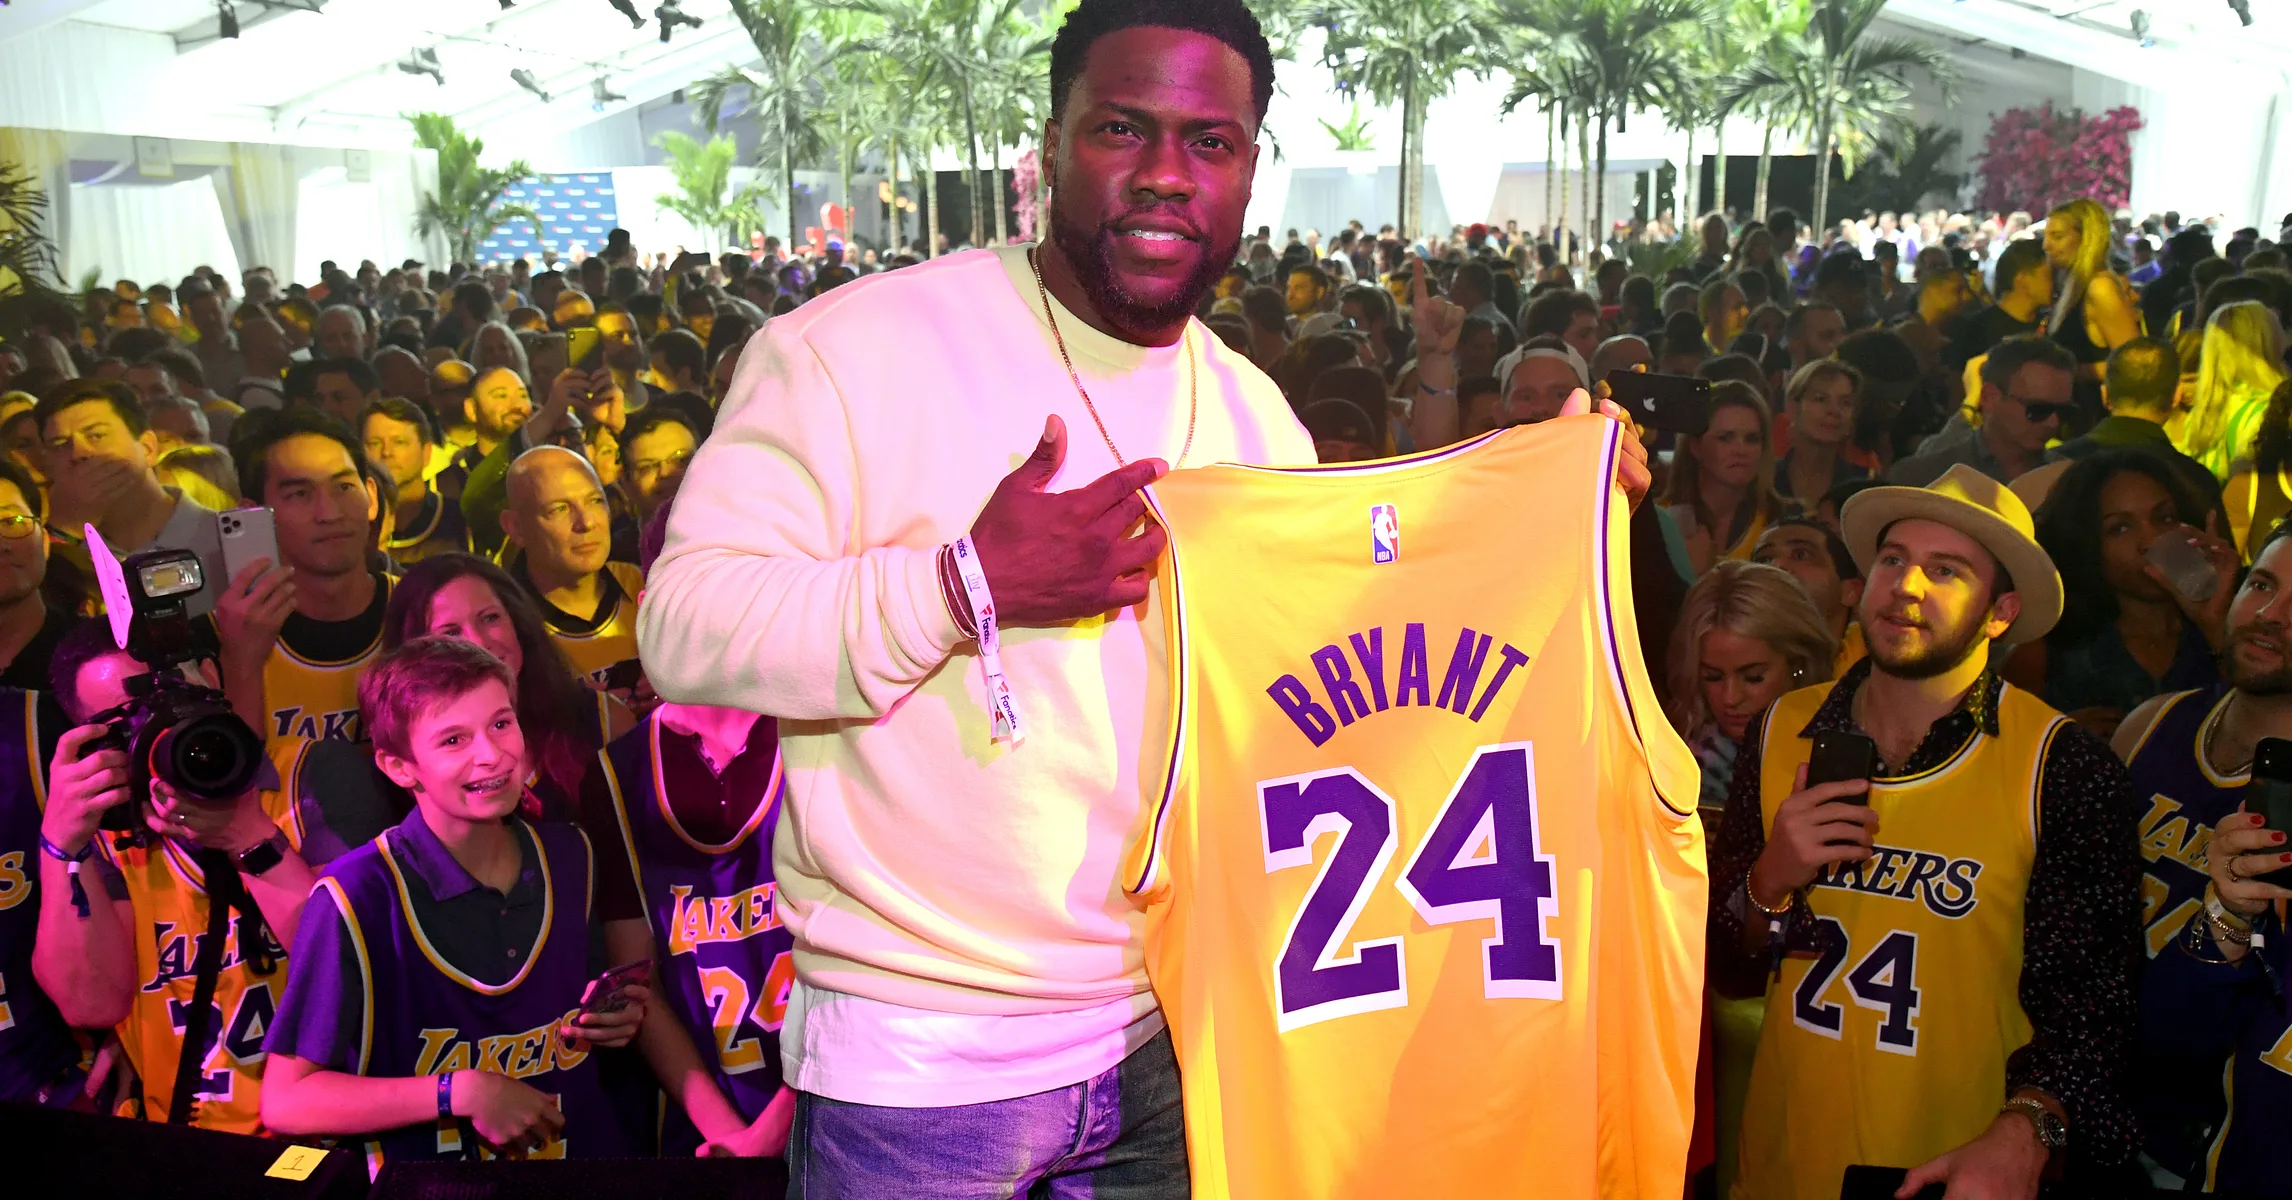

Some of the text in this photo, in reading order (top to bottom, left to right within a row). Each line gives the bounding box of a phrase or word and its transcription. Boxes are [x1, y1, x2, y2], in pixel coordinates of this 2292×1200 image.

[1376, 550, 1391, 562] NBA
[1001, 694, 1017, 730] Fanatics
[1266, 623, 1529, 747] BRYANT
[1256, 740, 1563, 1034] 24
[1812, 844, 1984, 920] KERS
[1793, 915, 1922, 1057] 24
[414, 1008, 593, 1080] LAKERS
[282, 1155, 305, 1171] 1
